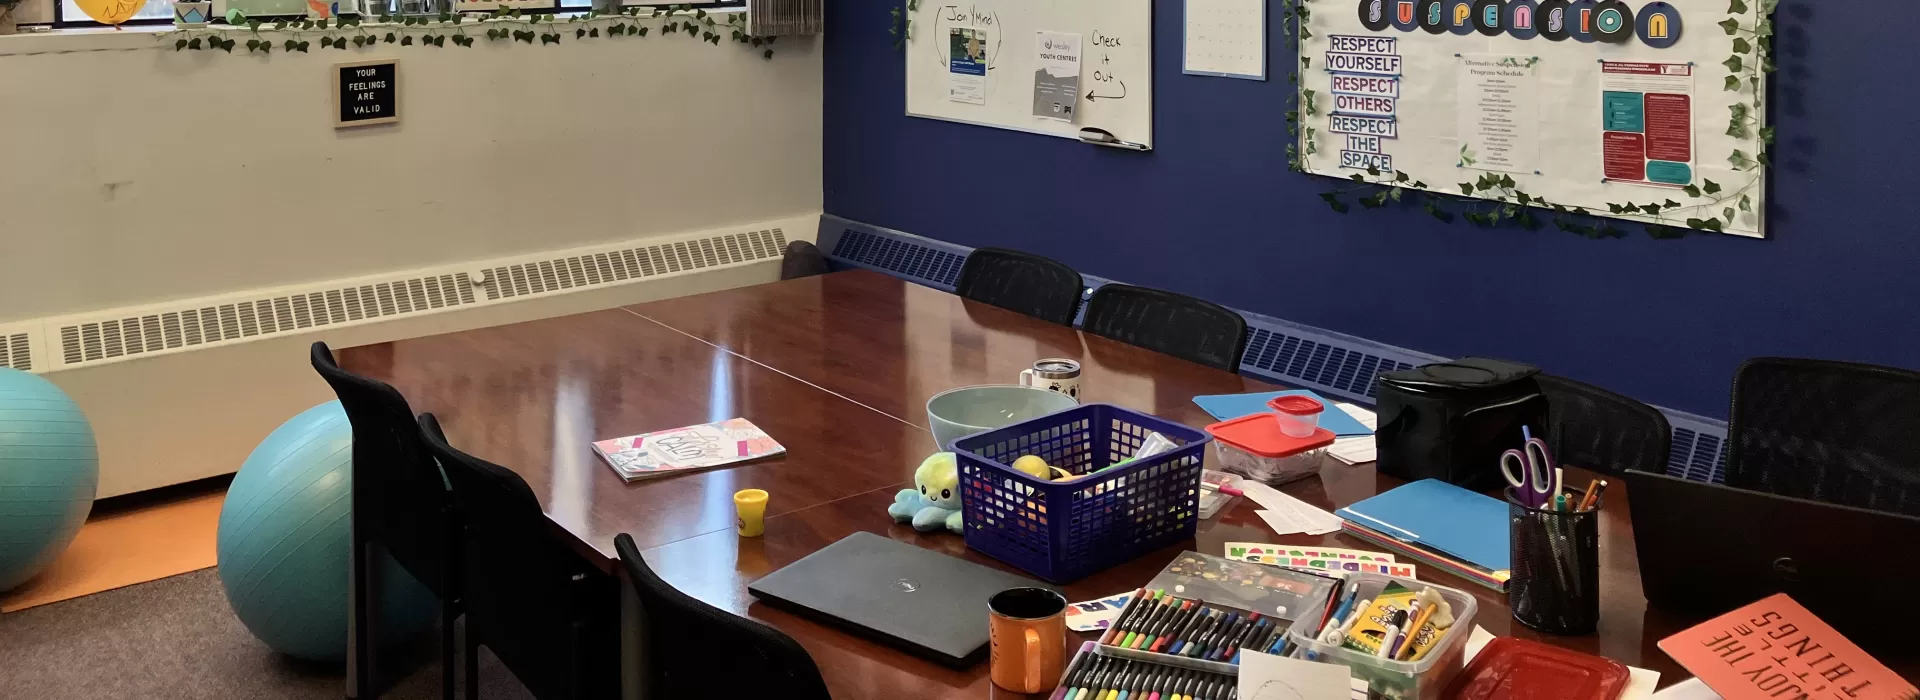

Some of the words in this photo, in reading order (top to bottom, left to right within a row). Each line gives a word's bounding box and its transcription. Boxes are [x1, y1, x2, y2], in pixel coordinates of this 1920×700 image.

[1092, 29, 1121, 47] Check
[1332, 37, 1394, 53] RESPECT
[1053, 41, 1070, 52] wesley
[1056, 54, 1077, 62] CENTRES
[1101, 53, 1110, 65] it
[1327, 55, 1399, 72] YOURSELF
[356, 69, 376, 77] YOUR
[349, 81, 386, 91] FEELINGS
[1334, 77, 1396, 93] RESPECT
[358, 92, 374, 101] ARE
[1337, 96, 1392, 112] OTHERS
[353, 104, 380, 114] VALID
[1332, 117, 1395, 134] RESPECT
[1350, 136, 1377, 151] THE
[1343, 152, 1389, 170] SPACE
[1701, 630, 1755, 668] THE
[1750, 611, 1872, 698] THINGS
